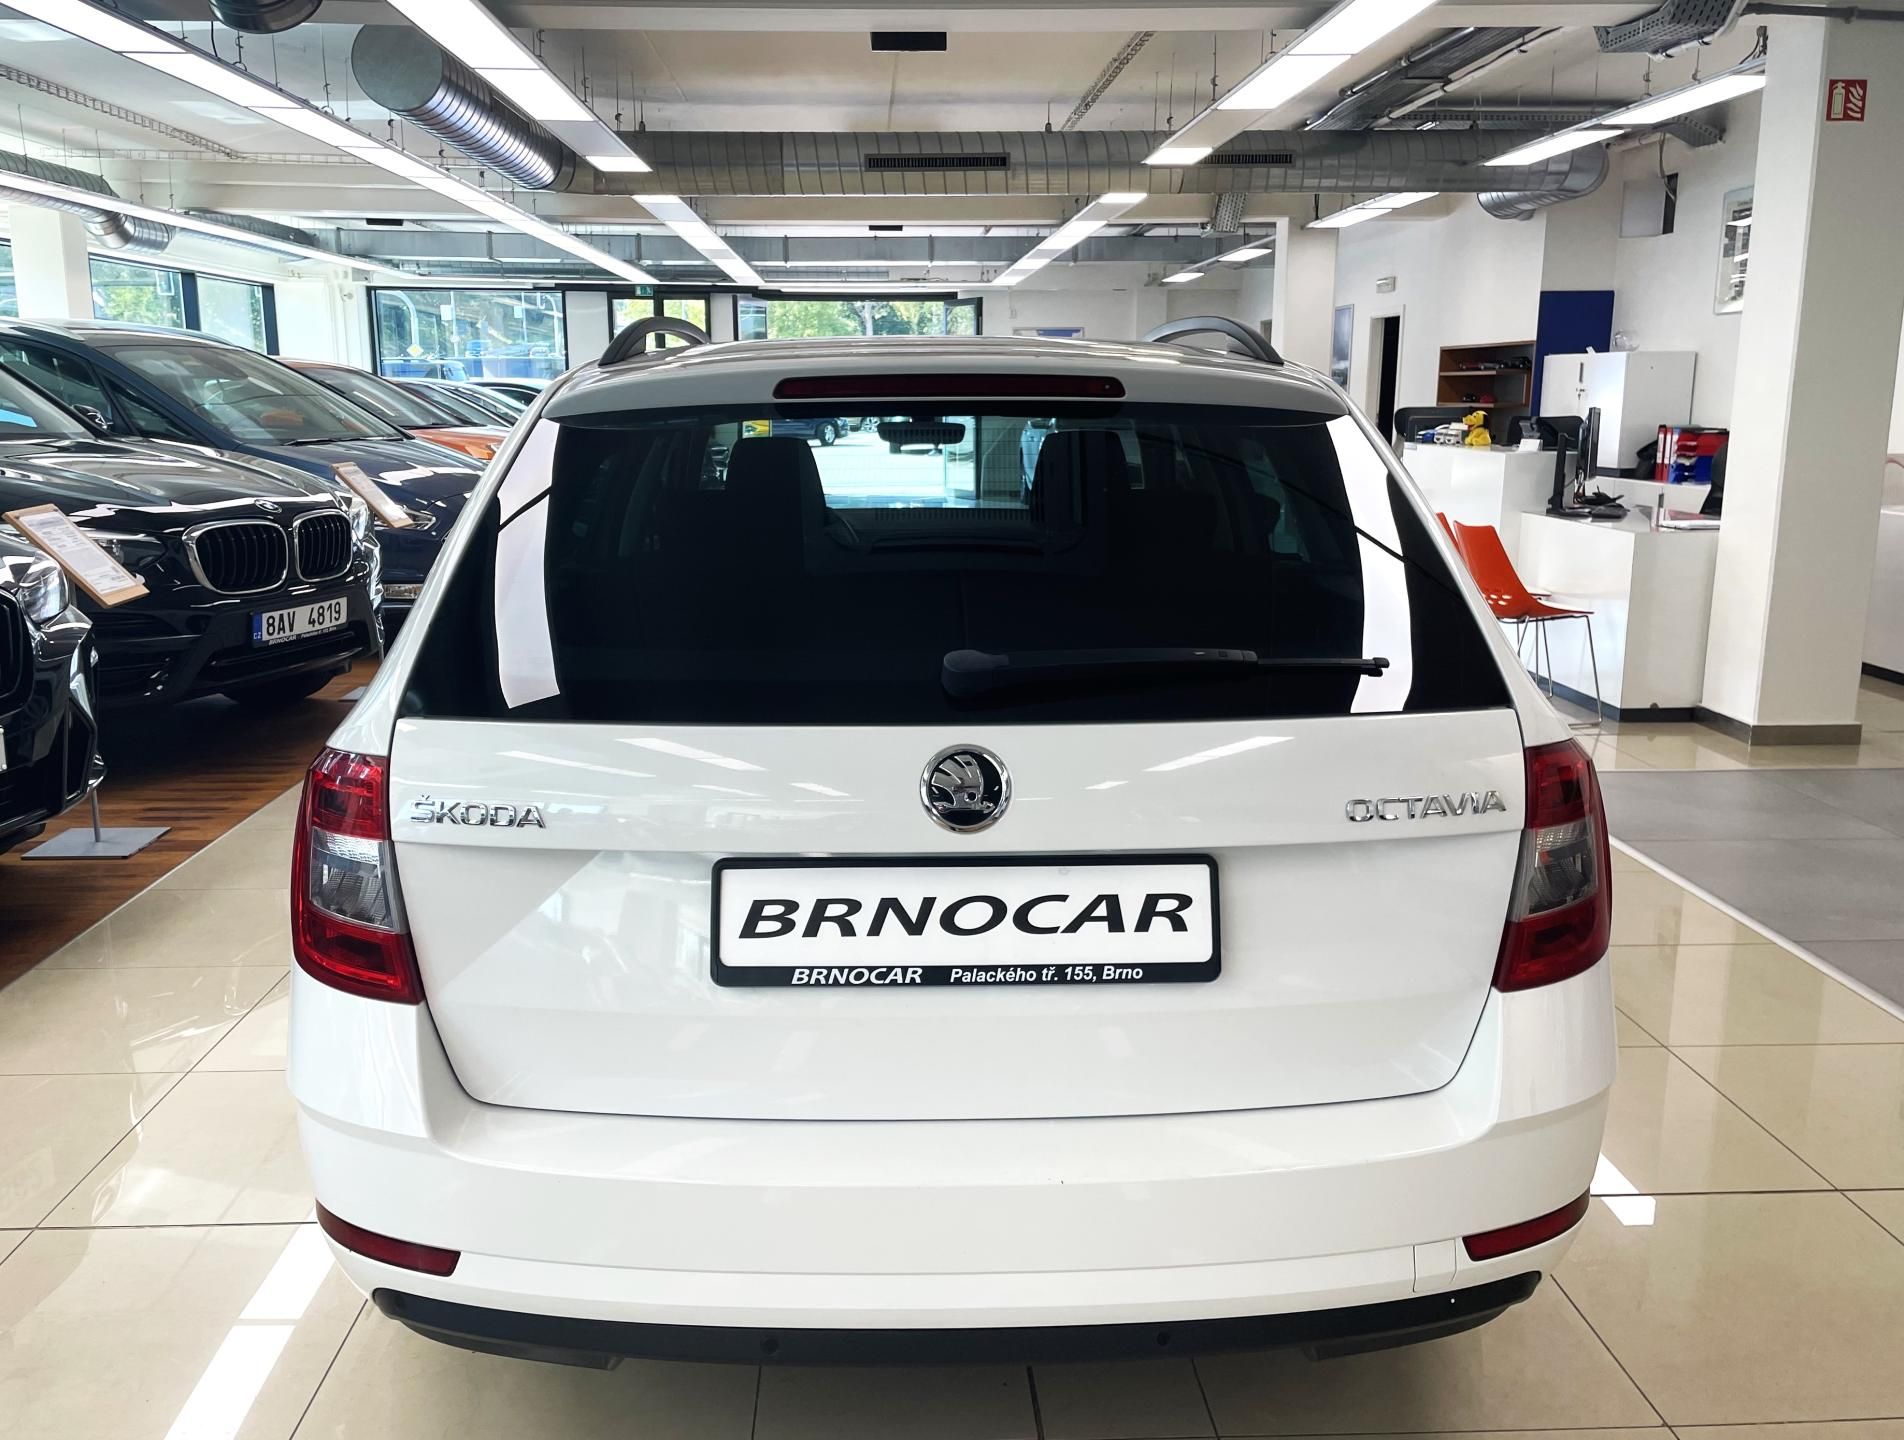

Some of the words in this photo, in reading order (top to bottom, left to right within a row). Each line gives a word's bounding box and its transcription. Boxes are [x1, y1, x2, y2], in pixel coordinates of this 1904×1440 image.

[266, 611, 296, 636] 8AV
[308, 601, 341, 627] 4819
[410, 794, 546, 828] ŠKODA
[1346, 790, 1507, 822] OCTAVIA
[738, 893, 1193, 939] BRNOCAR
[791, 967, 923, 985] BRNOCAR
[950, 967, 1037, 983] Palackého
[1041, 966, 1058, 981] tř.
[1064, 966, 1097, 983] 155,
[1102, 965, 1143, 980] Brno
